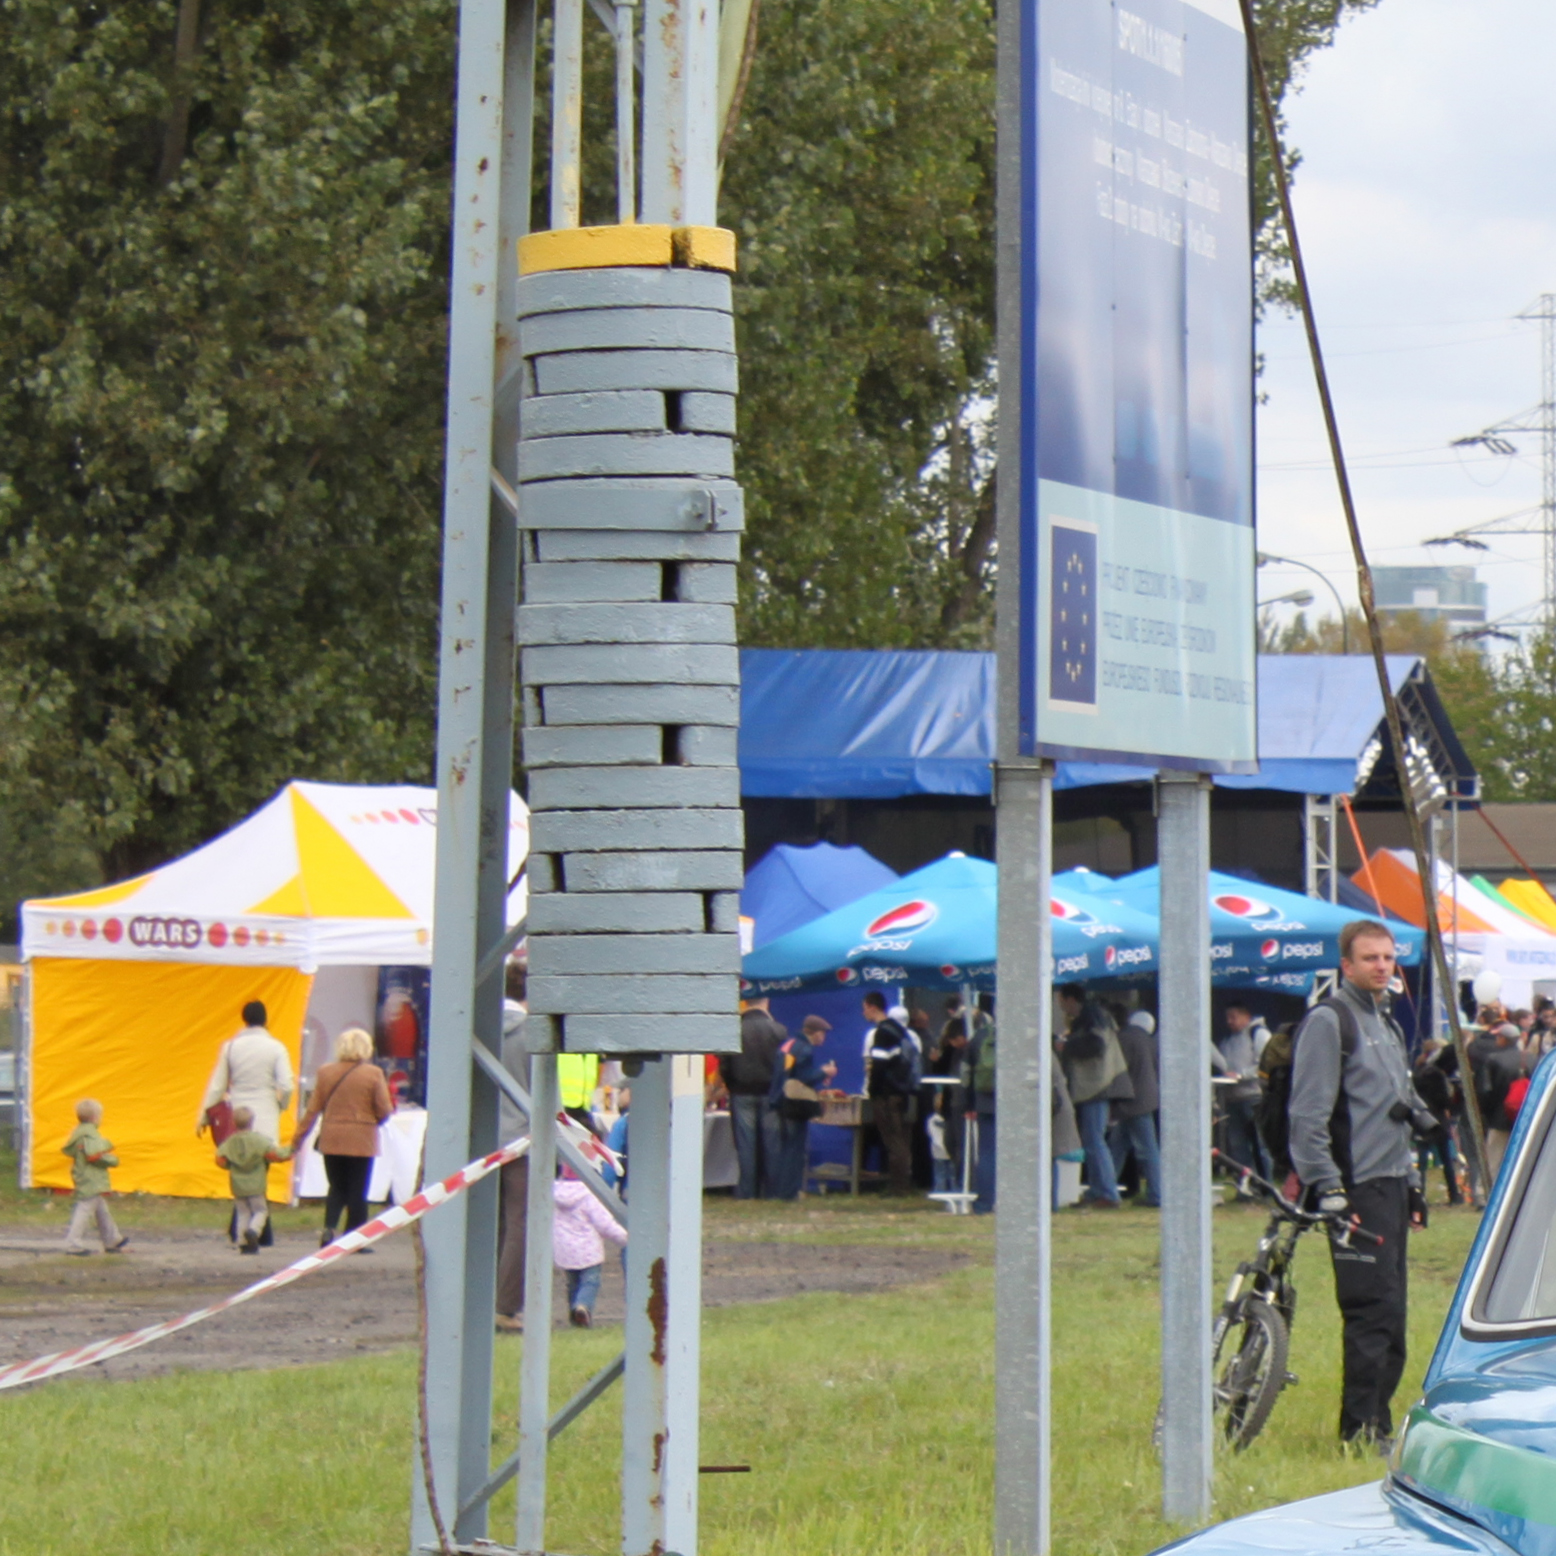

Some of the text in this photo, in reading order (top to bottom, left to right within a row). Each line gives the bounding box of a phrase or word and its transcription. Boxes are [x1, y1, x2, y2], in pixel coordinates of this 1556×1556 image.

[134, 920, 199, 944] WARS
[1117, 945, 1152, 967] pepsi
[1282, 941, 1324, 960] pepsi
[1057, 952, 1089, 975] pepsi
[862, 965, 909, 983] pepsi
[759, 976, 803, 994] pepsi
